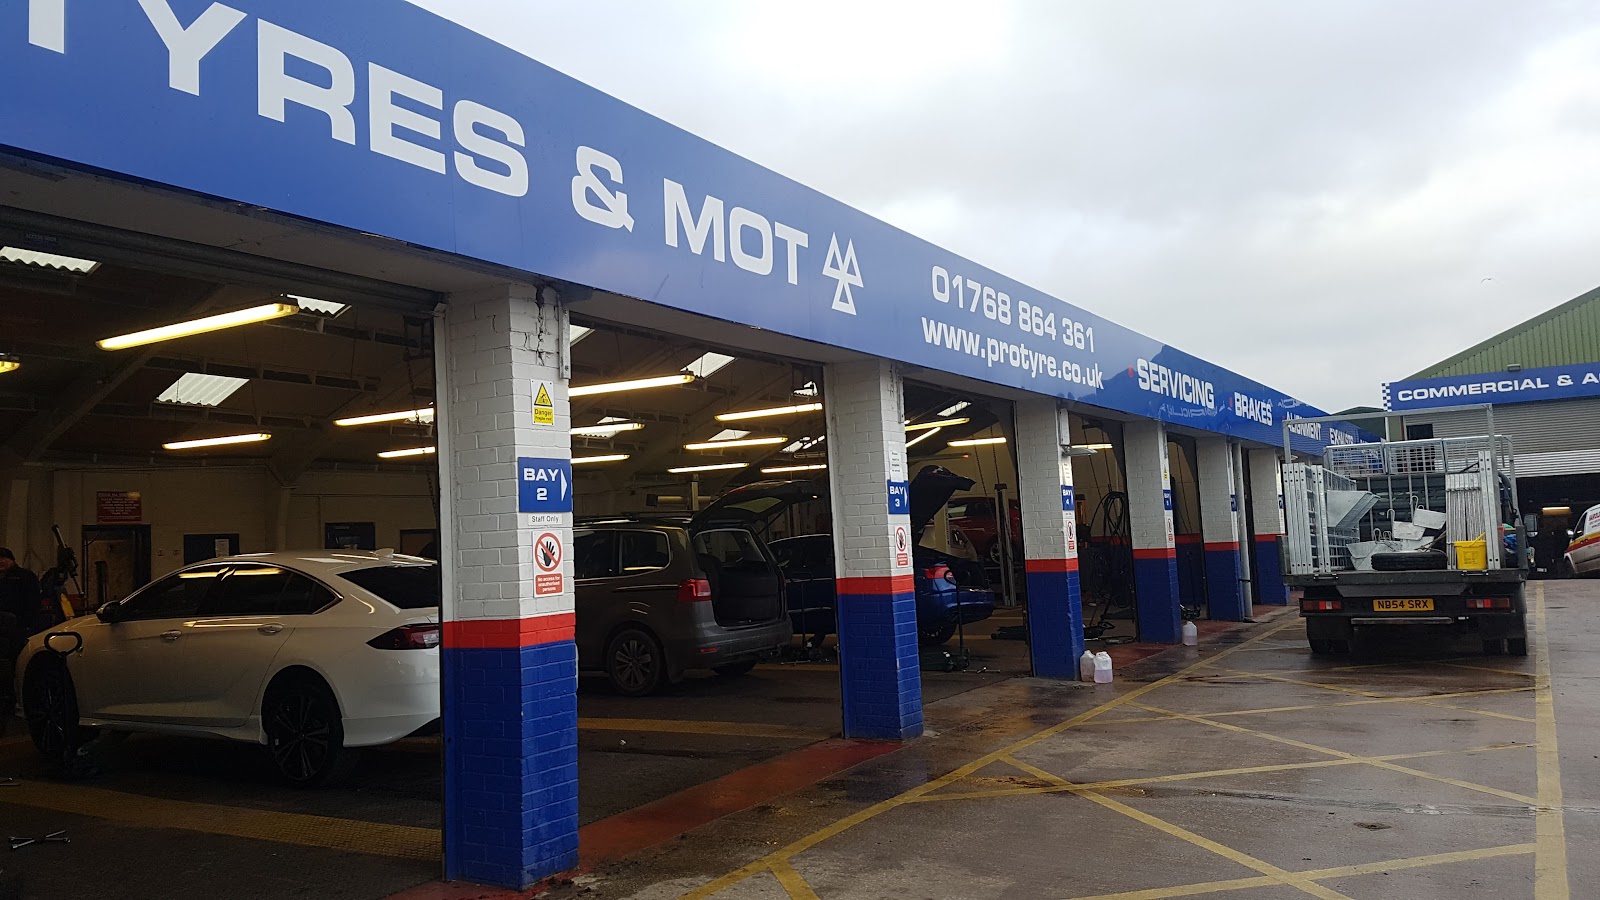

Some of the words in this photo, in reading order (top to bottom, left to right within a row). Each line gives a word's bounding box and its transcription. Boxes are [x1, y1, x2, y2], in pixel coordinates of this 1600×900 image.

[571, 145, 634, 233] &
[664, 178, 810, 286] MOT
[931, 265, 1012, 325] 01768
[1018, 300, 1056, 340] 864
[1061, 317, 1095, 353] 361
[921, 316, 1104, 390] www.protyre.co.uk
[1136, 358, 1215, 409] SERVICING
[1397, 377, 1550, 402] COMMERCIAL
[1557, 374, 1574, 386] &
[1581, 372, 1600, 385] A
[534, 409, 552, 417] Danger
[1234, 391, 1273, 426] BRAKES
[523, 467, 559, 482] BAY
[536, 487, 548, 501] 2
[889, 485, 904, 495] BAY
[894, 498, 900, 507] 3
[1377, 600, 1405, 609] NB54
[1407, 600, 1429, 608] SRX
